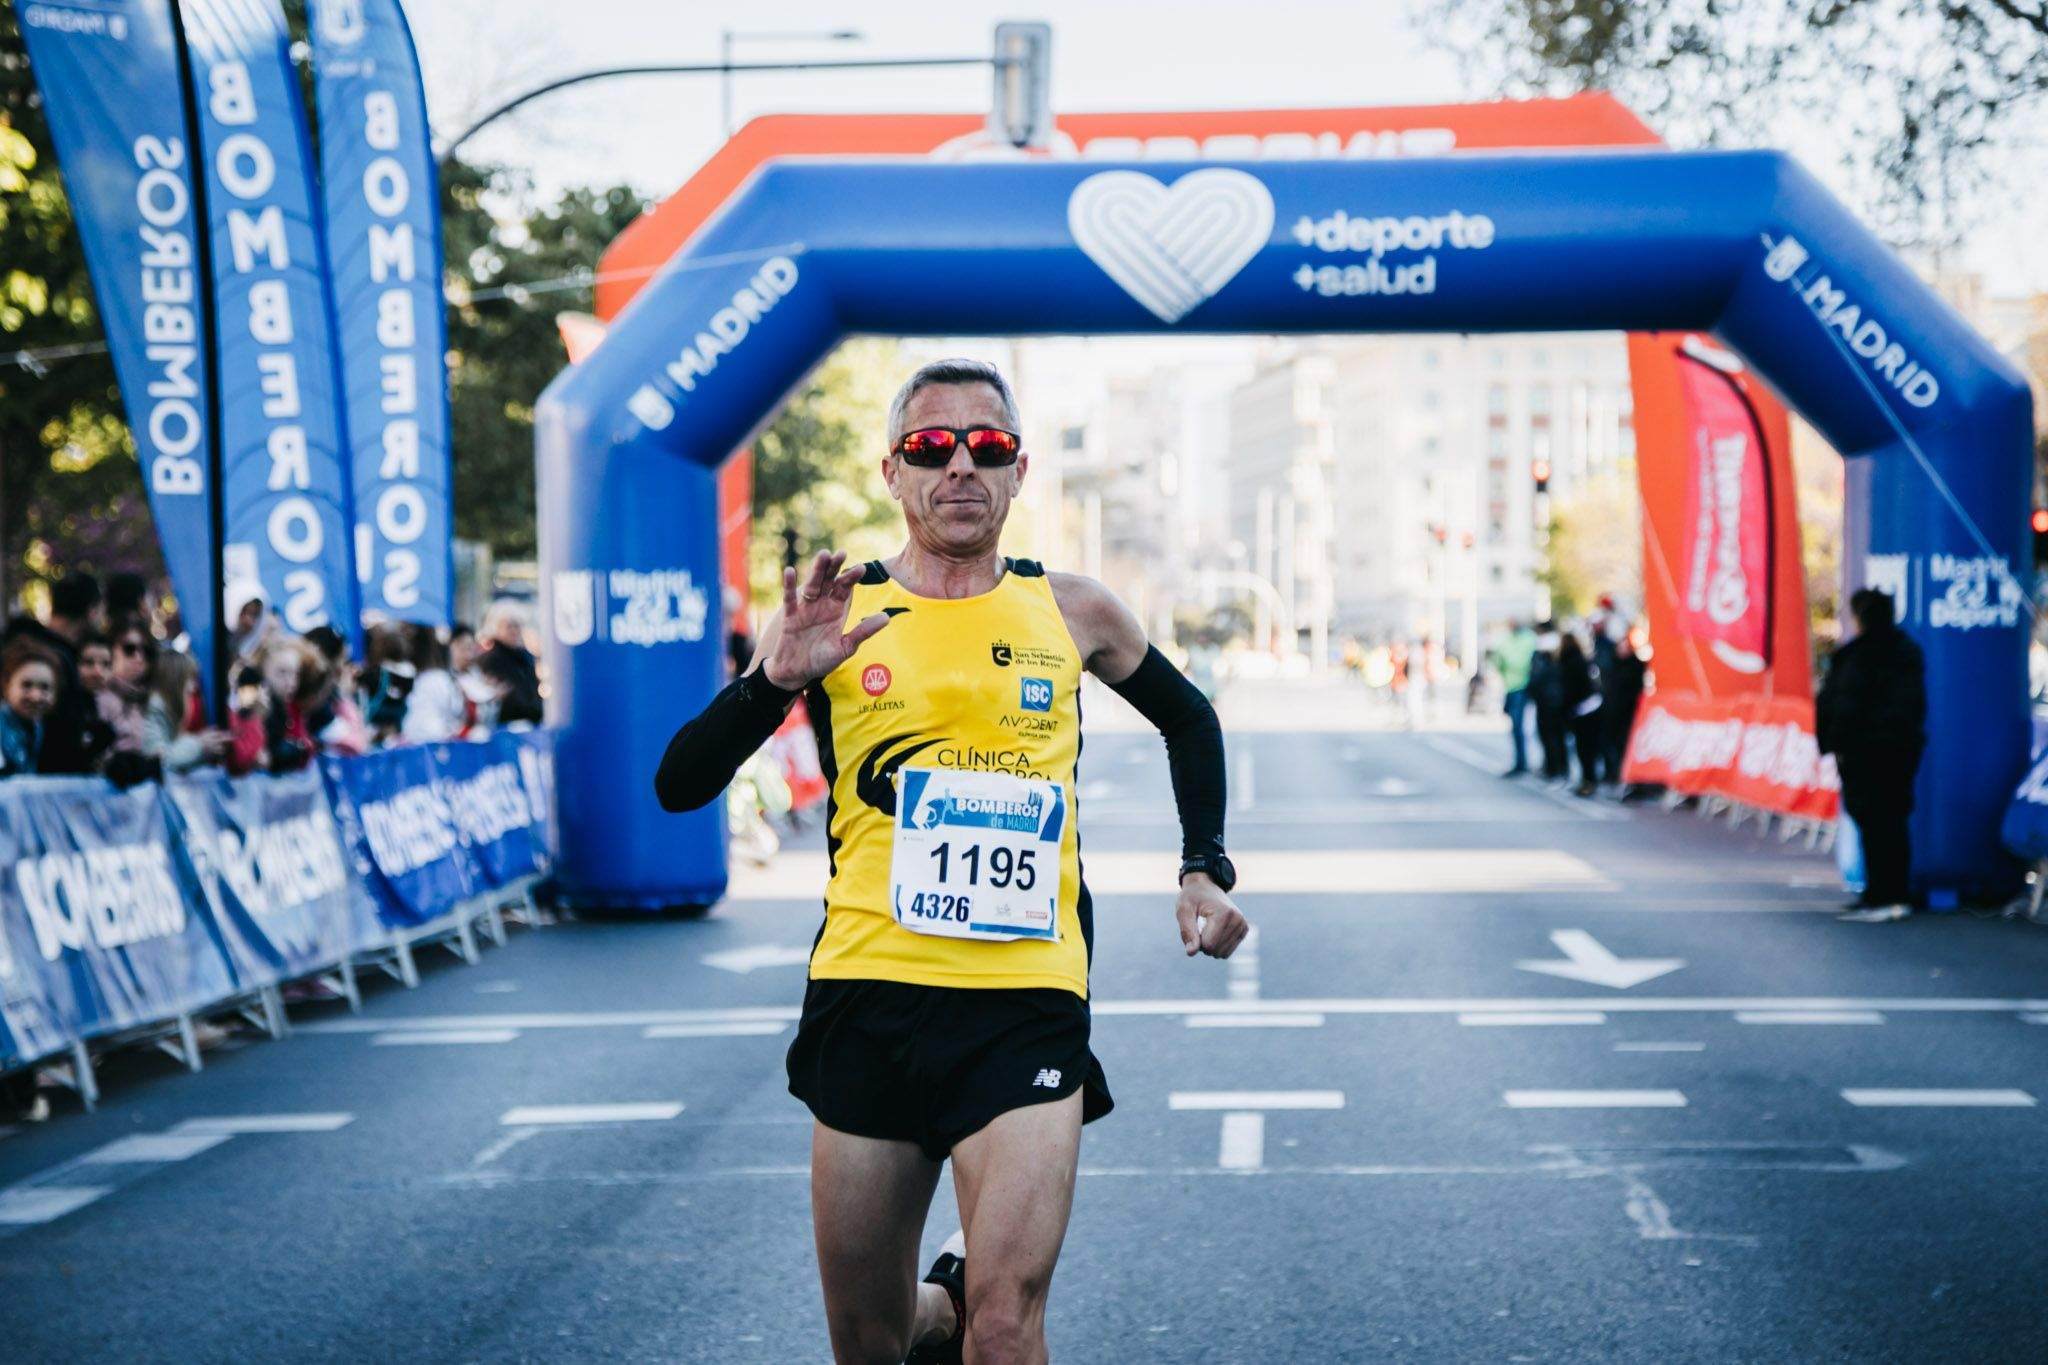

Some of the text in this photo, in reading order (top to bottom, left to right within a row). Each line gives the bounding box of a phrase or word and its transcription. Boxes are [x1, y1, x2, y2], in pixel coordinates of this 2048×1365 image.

[1292, 210, 1497, 257] +deporte
[1293, 256, 1438, 298] +salud
[667, 256, 800, 391] MADRID
[1803, 275, 1941, 409] MADRID
[1025, 684, 1050, 704] ISC
[938, 746, 1030, 768] CLÍNICA
[956, 797, 1040, 818] BOMBEROS
[991, 816, 1038, 832] de MADRID
[929, 841, 1036, 891] 1195
[911, 892, 970, 923] 4326
